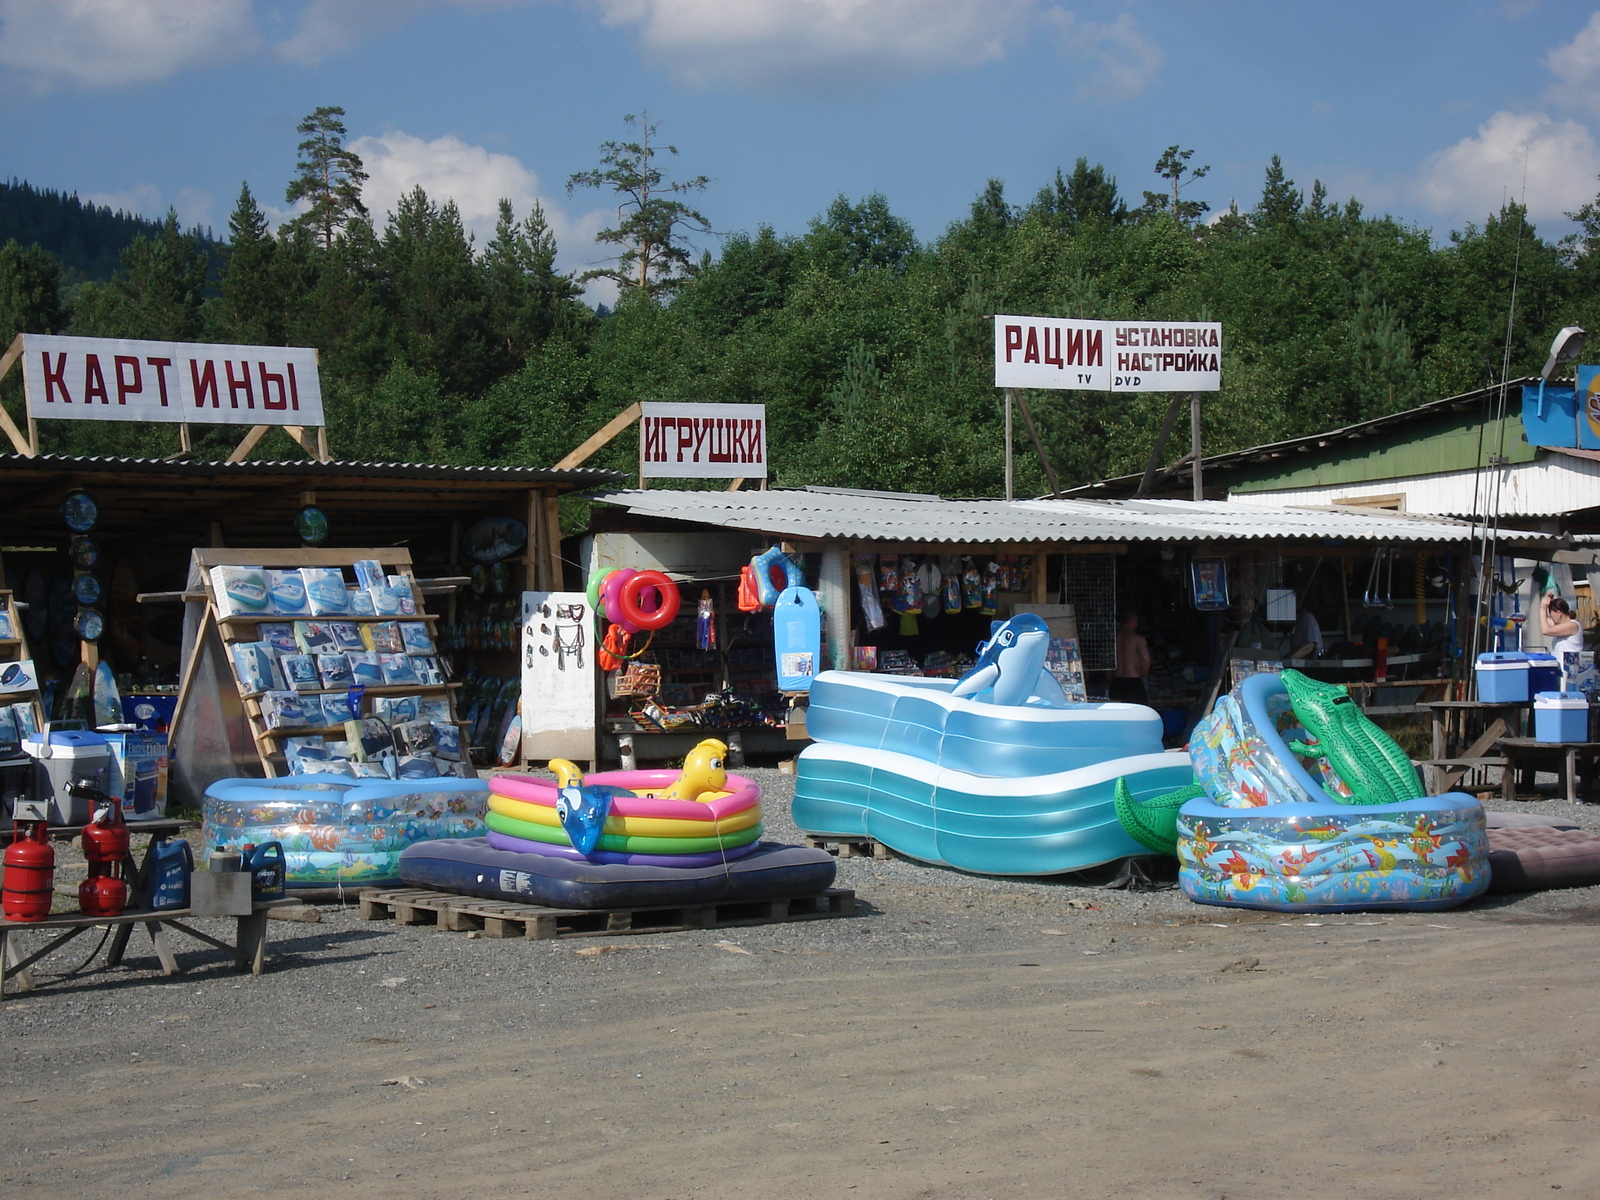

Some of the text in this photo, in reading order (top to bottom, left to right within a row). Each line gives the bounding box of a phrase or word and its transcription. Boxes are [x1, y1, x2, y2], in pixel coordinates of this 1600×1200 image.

[1005, 325, 1103, 369] РАЦИИ
[1116, 327, 1219, 347] УСТАНОВКА
[1118, 349, 1219, 372] НАСТРОЙКА
[42, 351, 299, 411] КАРТИНЫ
[1077, 373, 1141, 386] TV DVD
[644, 417, 762, 463] ИГРУШКИ
